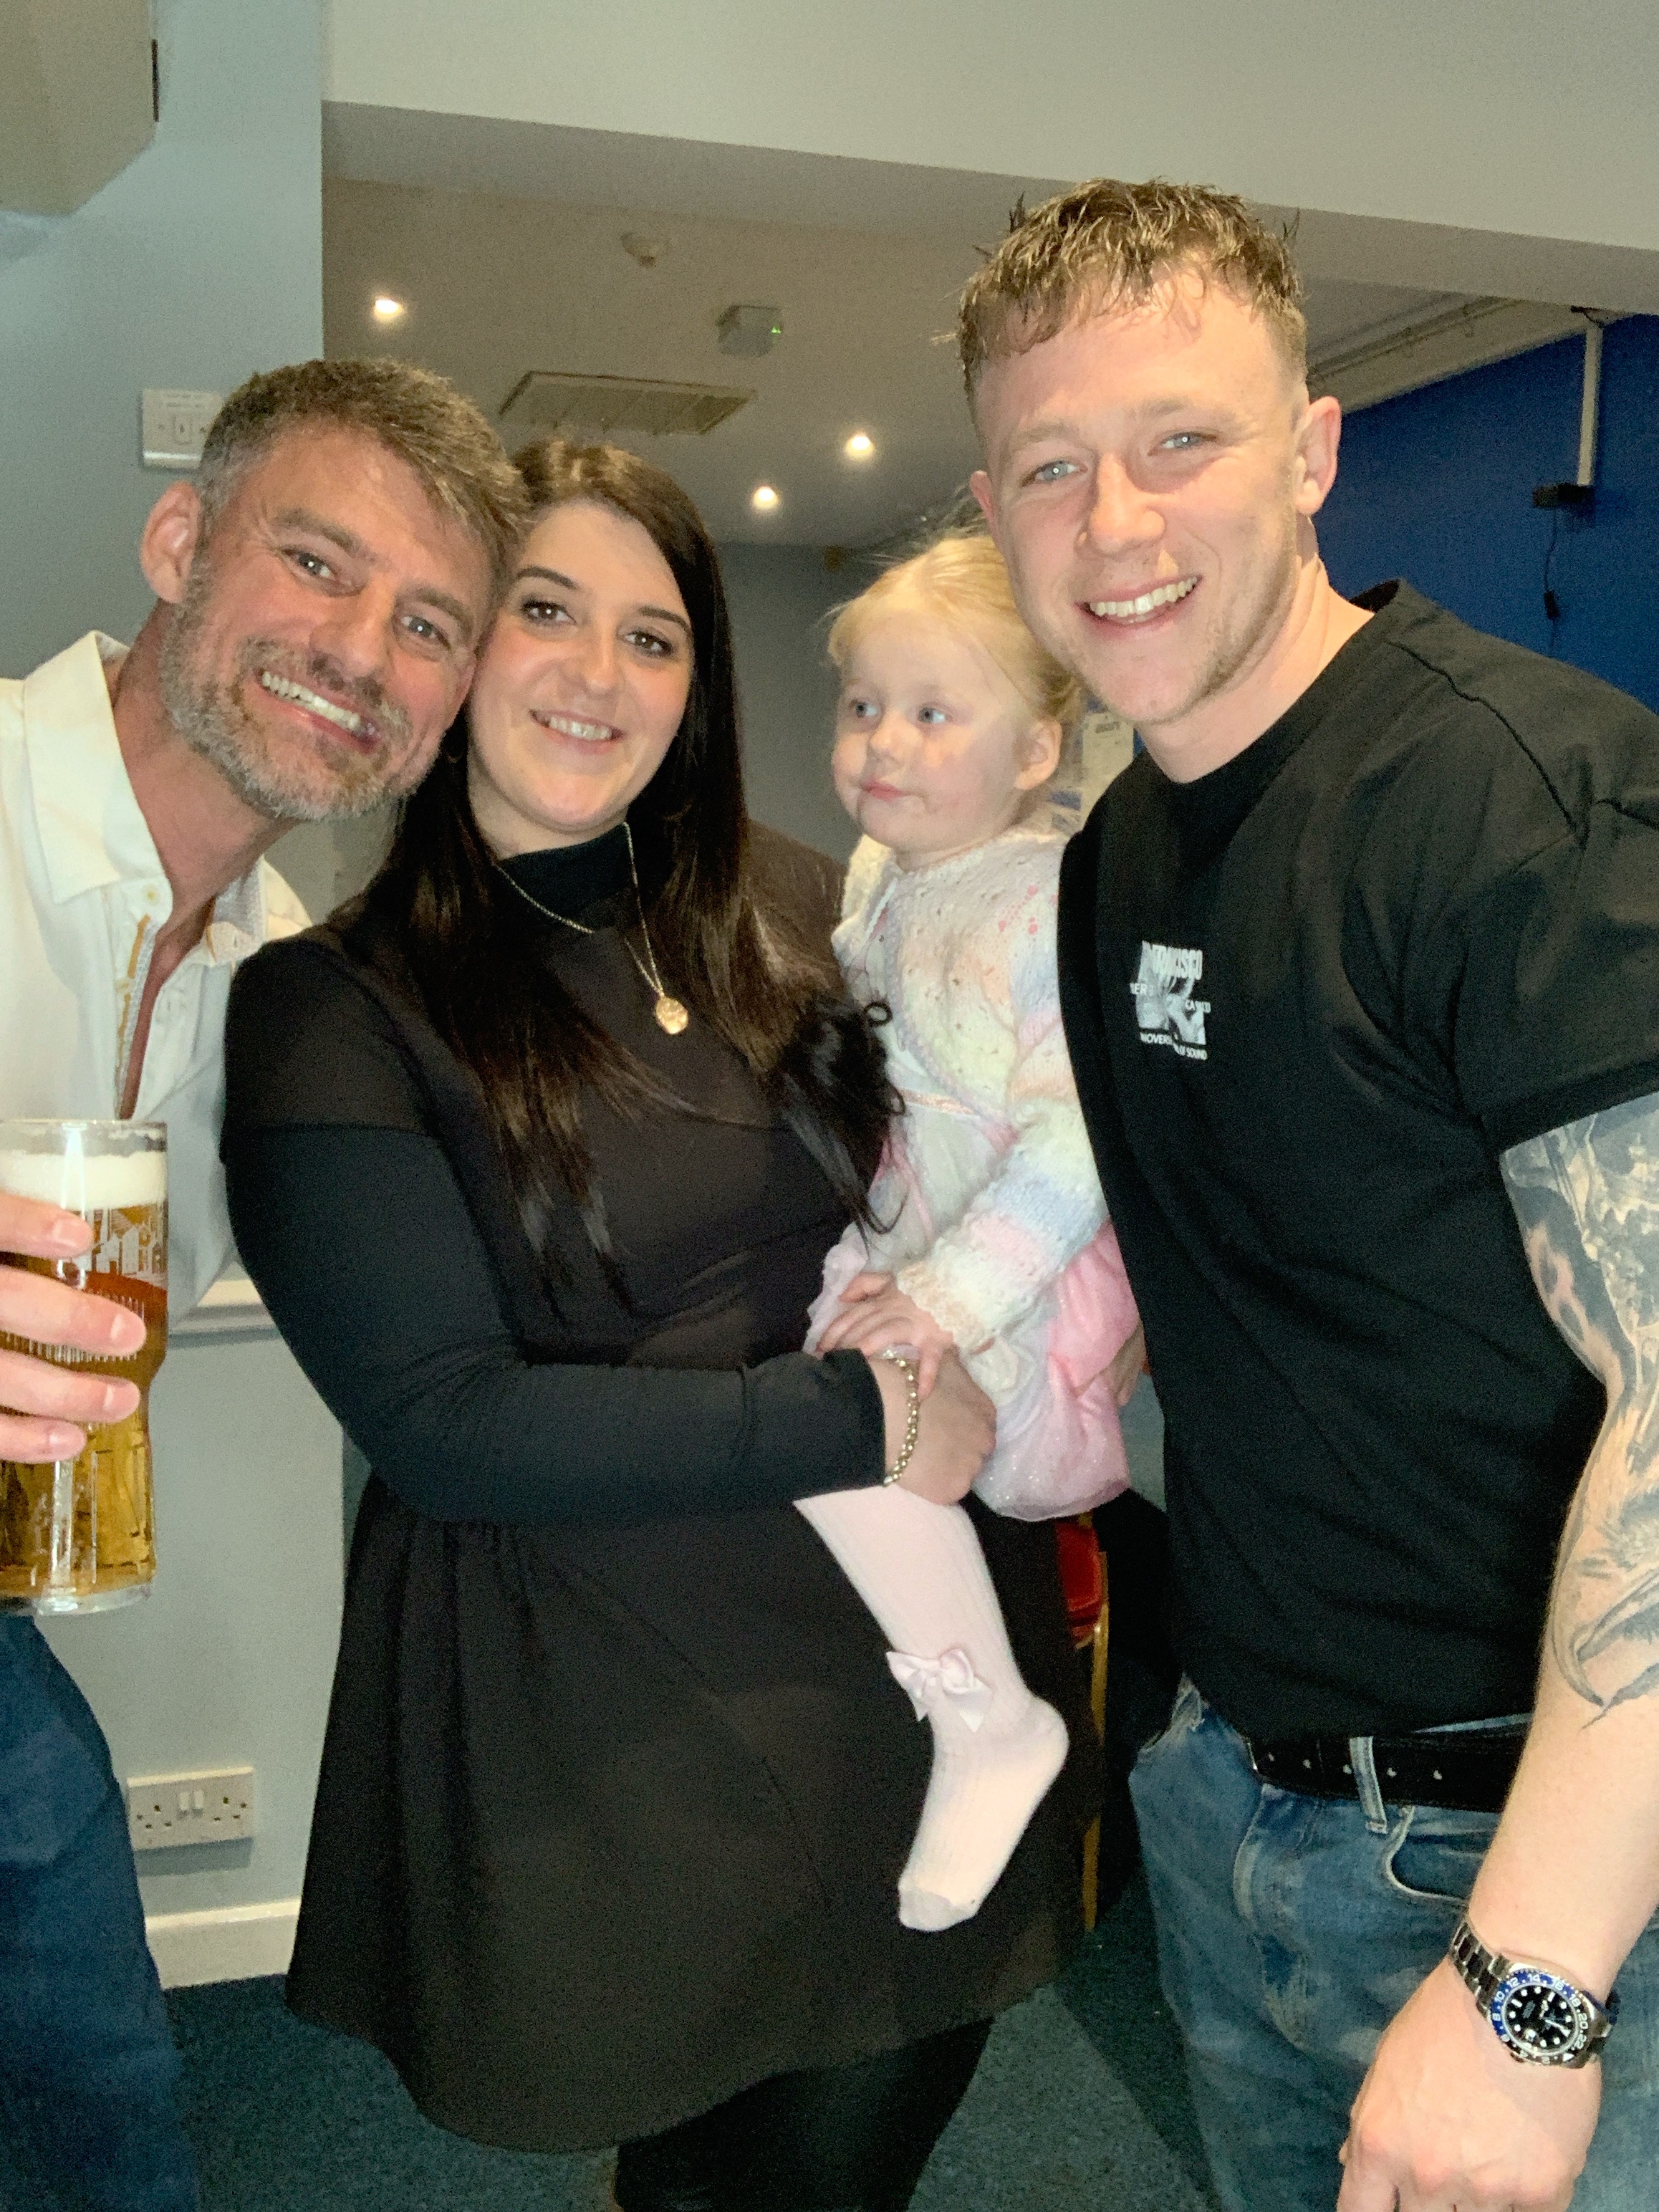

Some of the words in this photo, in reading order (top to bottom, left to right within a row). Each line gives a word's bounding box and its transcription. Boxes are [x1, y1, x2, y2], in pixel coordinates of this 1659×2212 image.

[1506, 1977, 1520, 1988] 12
[1527, 1973, 1540, 1982] 14
[1552, 1978, 1564, 1991] 16
[1494, 1991, 1505, 2003] 10
[1569, 1994, 1581, 2007] 18
[1492, 2013, 1501, 2021] 8
[1578, 2013, 1588, 2029] 20
[1574, 2034, 1587, 2049] 22
